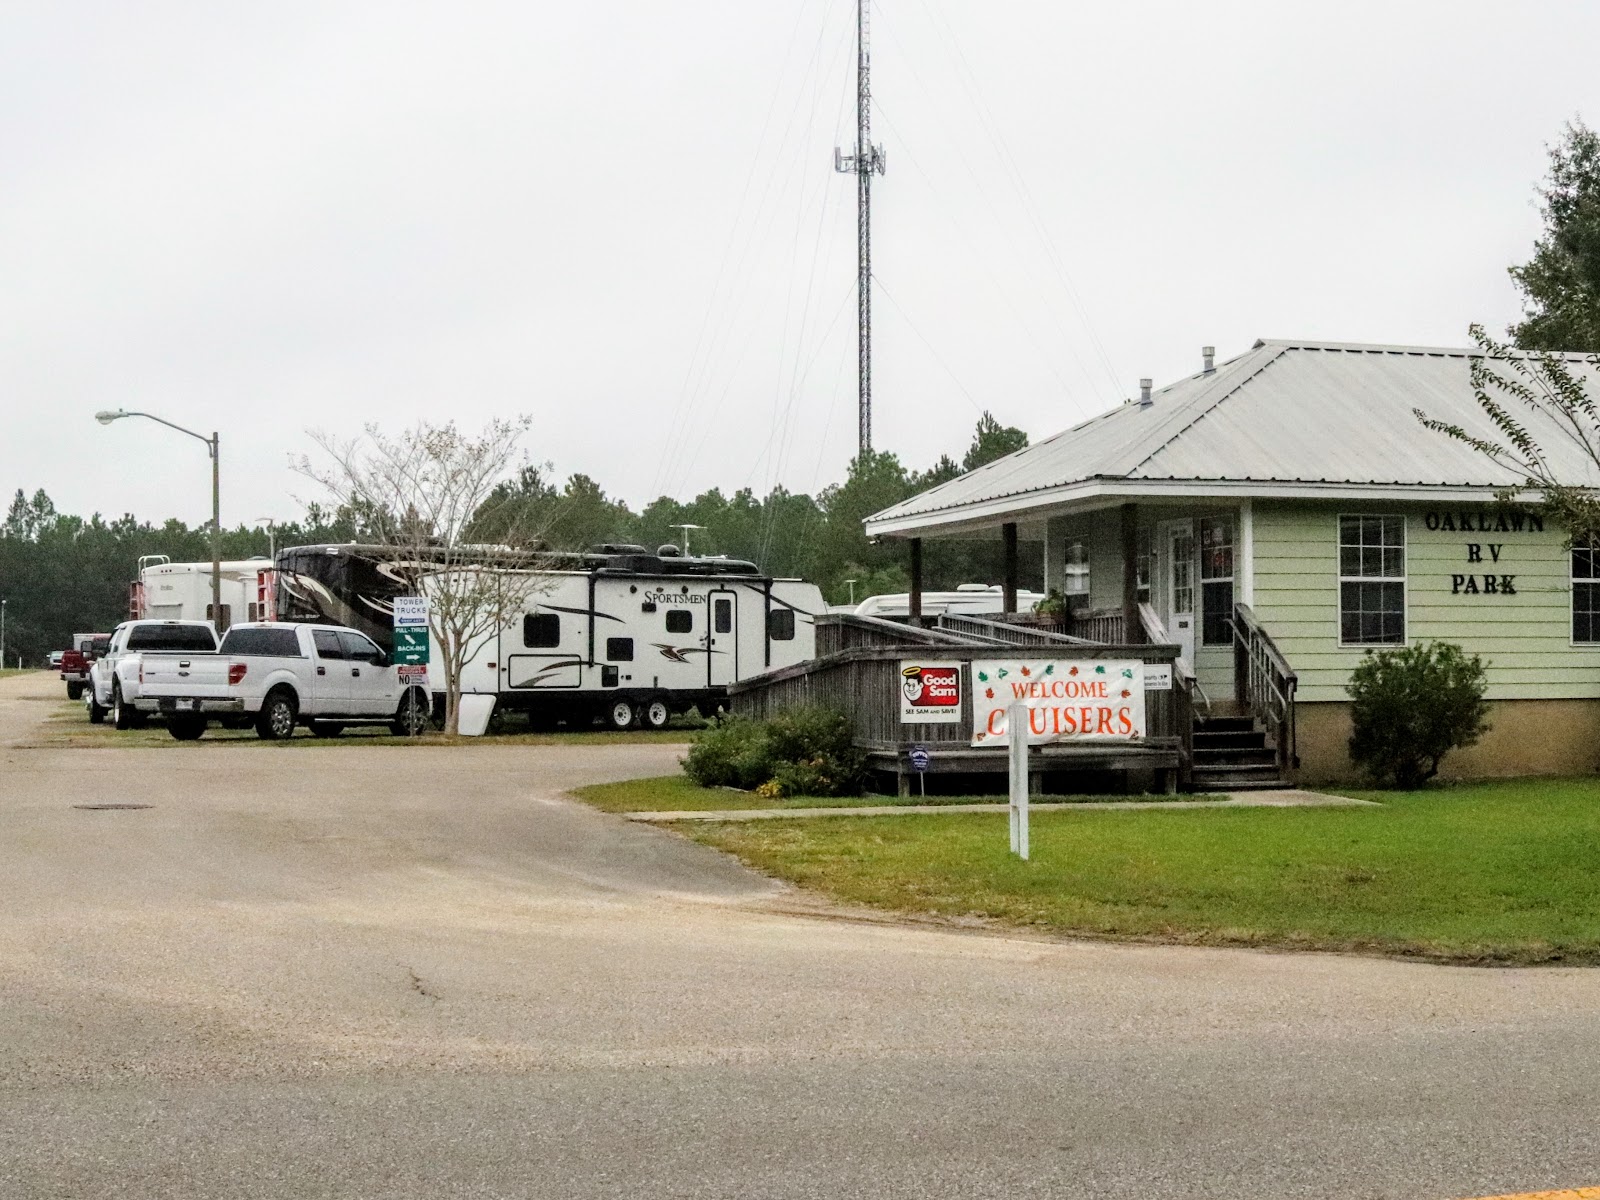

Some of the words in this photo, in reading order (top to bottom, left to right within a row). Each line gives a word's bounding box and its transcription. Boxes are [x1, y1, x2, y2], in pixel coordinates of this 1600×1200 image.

[1425, 511, 1544, 532] OAKLAWN
[1467, 543, 1503, 563] RV
[1451, 574, 1517, 594] PARK
[398, 674, 411, 685] NO
[923, 673, 957, 686] Good
[929, 685, 957, 697] Sam
[1010, 680, 1109, 699] WELCOME
[987, 706, 1132, 736] CUISERS
